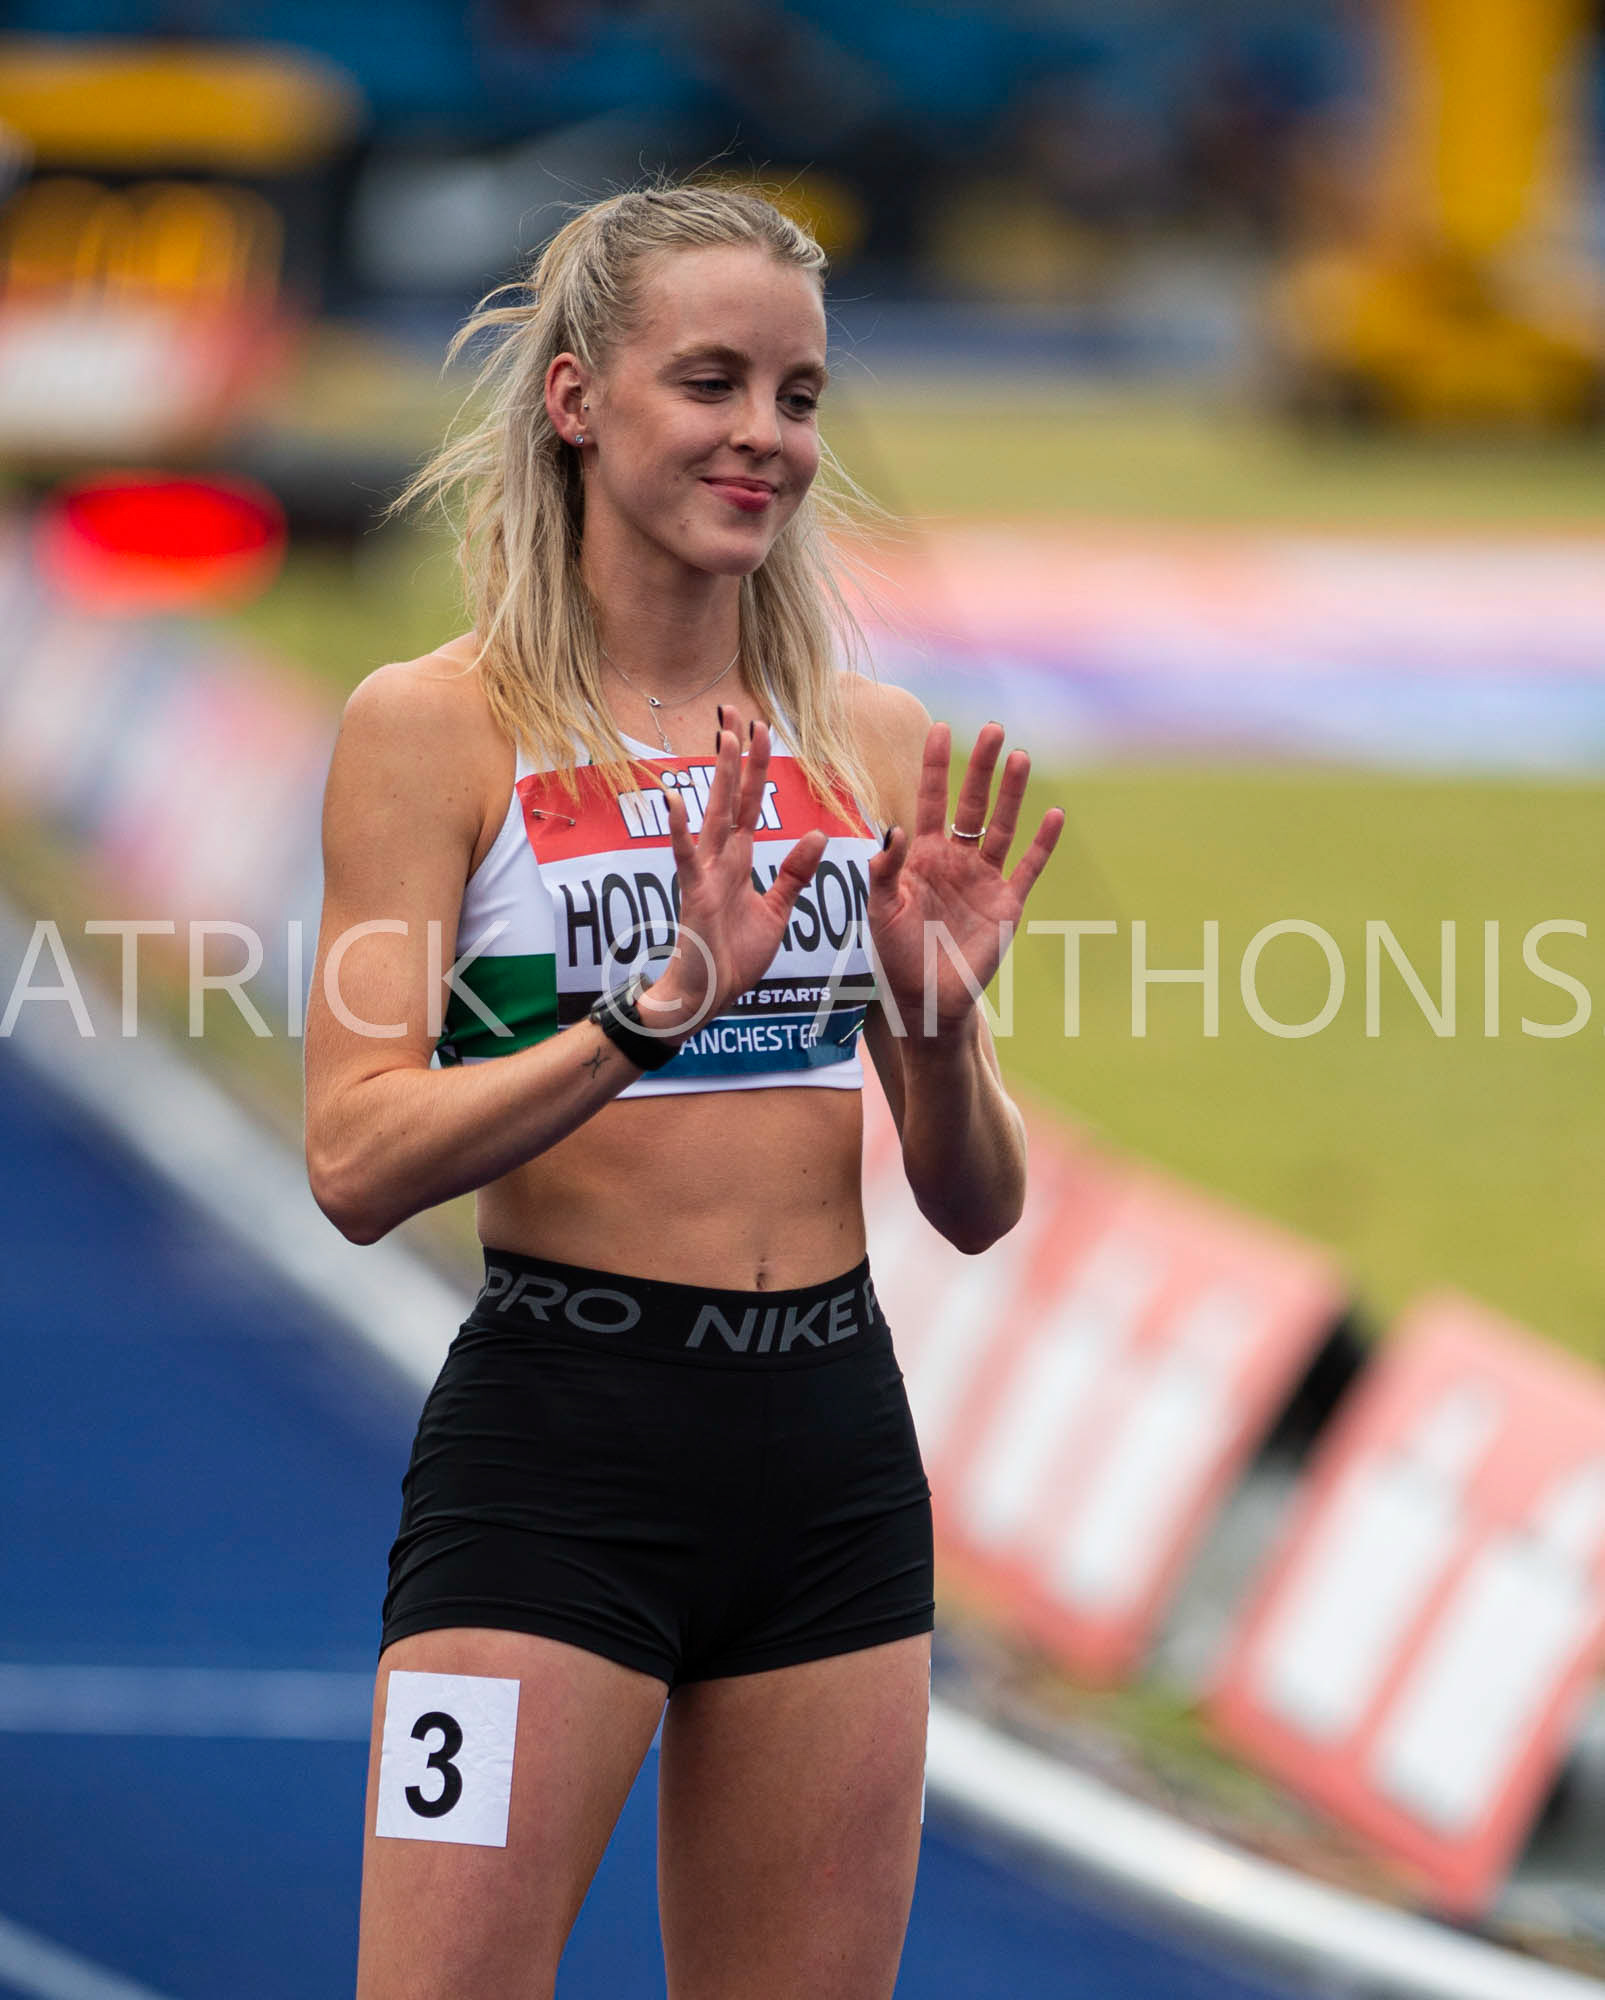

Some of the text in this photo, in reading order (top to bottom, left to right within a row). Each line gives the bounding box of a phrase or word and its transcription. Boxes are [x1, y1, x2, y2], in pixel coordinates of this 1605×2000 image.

[618, 765, 783, 839] mülr
[758, 987, 831, 1004] STARTS
[679, 1023, 820, 1056] ANCHESTER
[483, 1266, 641, 1334] PRO
[685, 1288, 858, 1354] NIKE
[405, 1711, 463, 1818] 3
